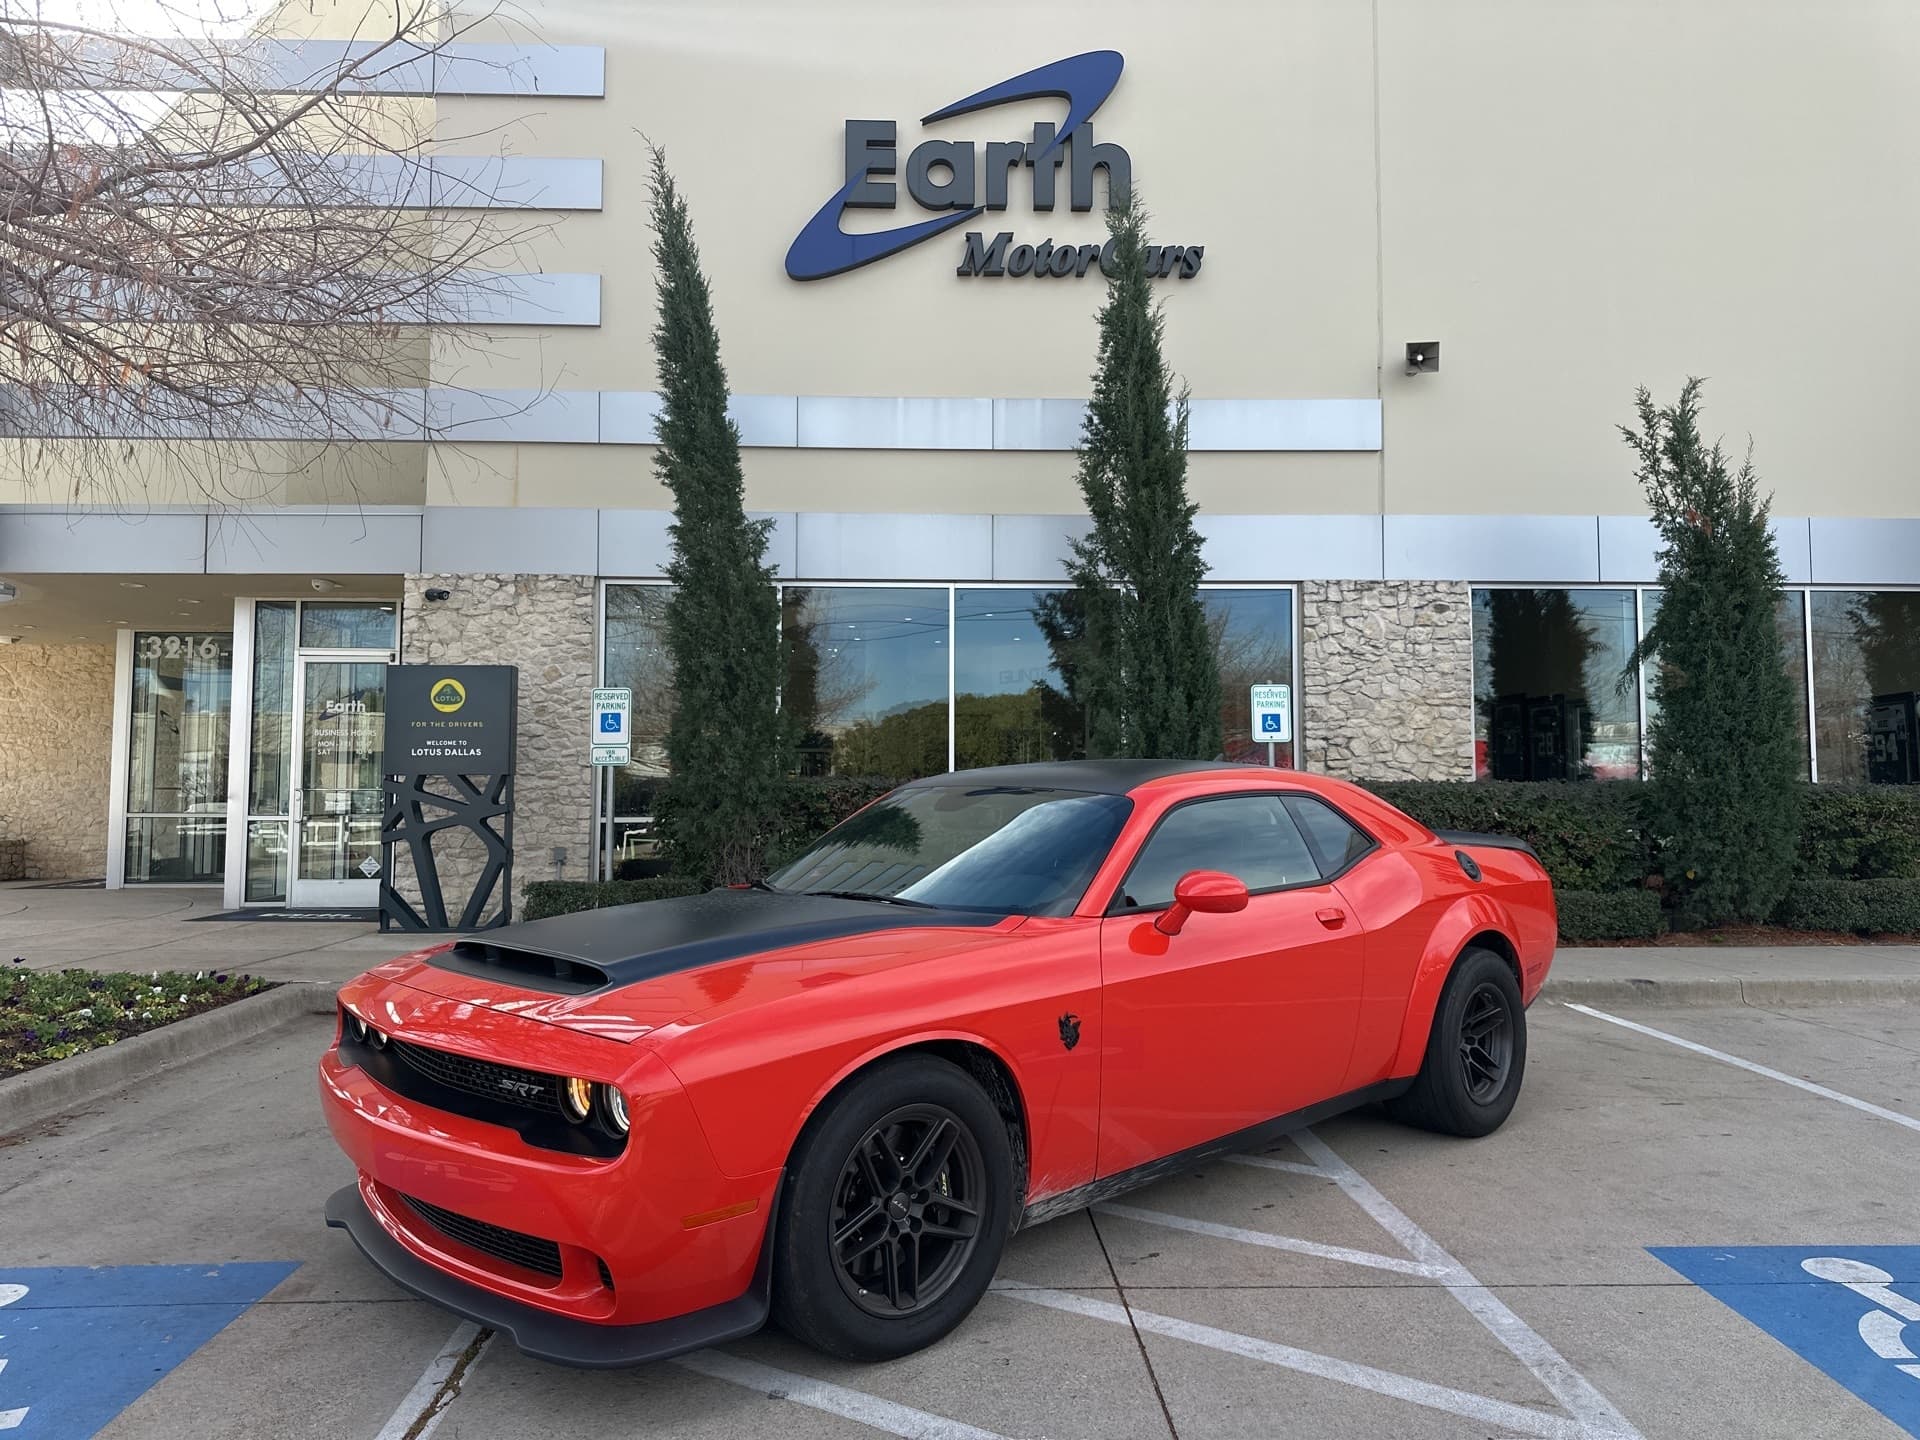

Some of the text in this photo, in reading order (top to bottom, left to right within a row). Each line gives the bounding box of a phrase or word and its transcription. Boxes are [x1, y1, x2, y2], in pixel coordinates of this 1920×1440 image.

[845, 119, 1132, 212] Earth
[594, 692, 629, 701] RESERVED
[1254, 690, 1287, 699] RESERVED
[326, 700, 366, 713] Earth
[596, 702, 626, 711] PARKING
[1256, 700, 1286, 709] PARKING
[314, 729, 349, 737] BUSINESS
[411, 748, 482, 756] LOTUS DALLAS
[498, 1079, 545, 1097] SRT
